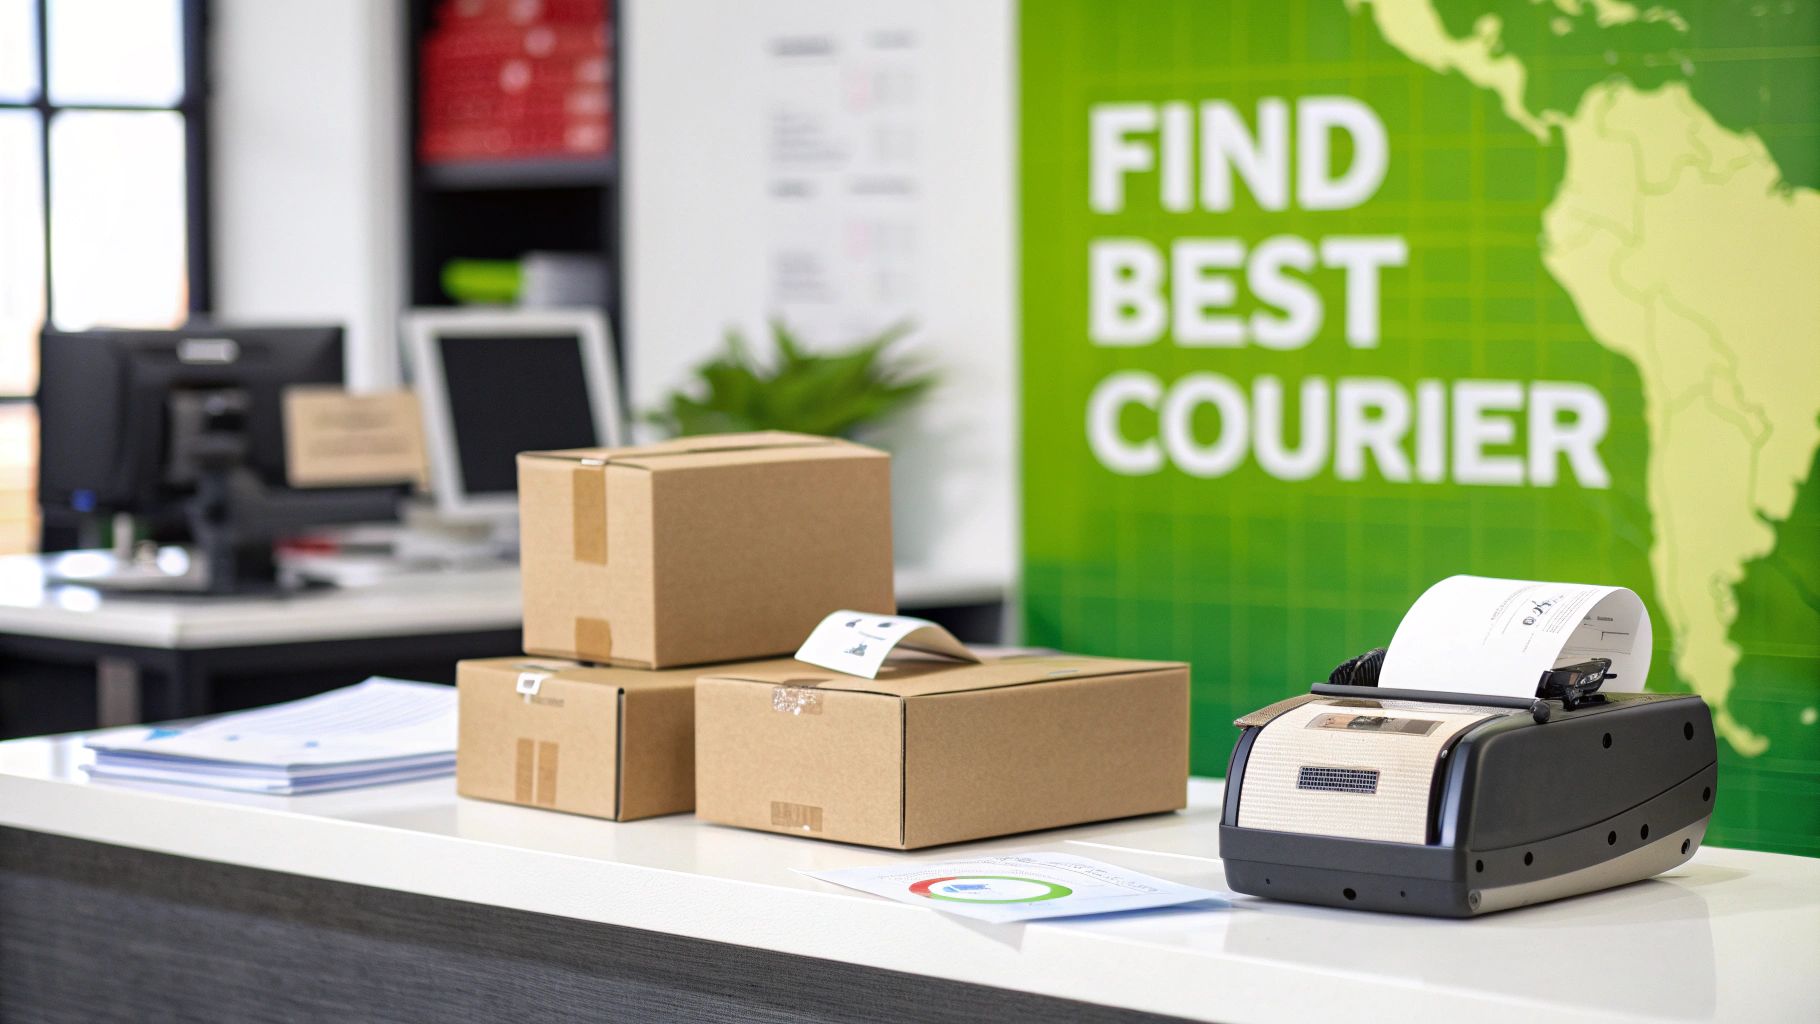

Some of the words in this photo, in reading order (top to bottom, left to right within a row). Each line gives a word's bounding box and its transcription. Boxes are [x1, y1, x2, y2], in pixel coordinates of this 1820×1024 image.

[1090, 96, 1388, 213] FIND
[1089, 236, 1408, 350] BEST
[1087, 372, 1609, 489] COURIER
